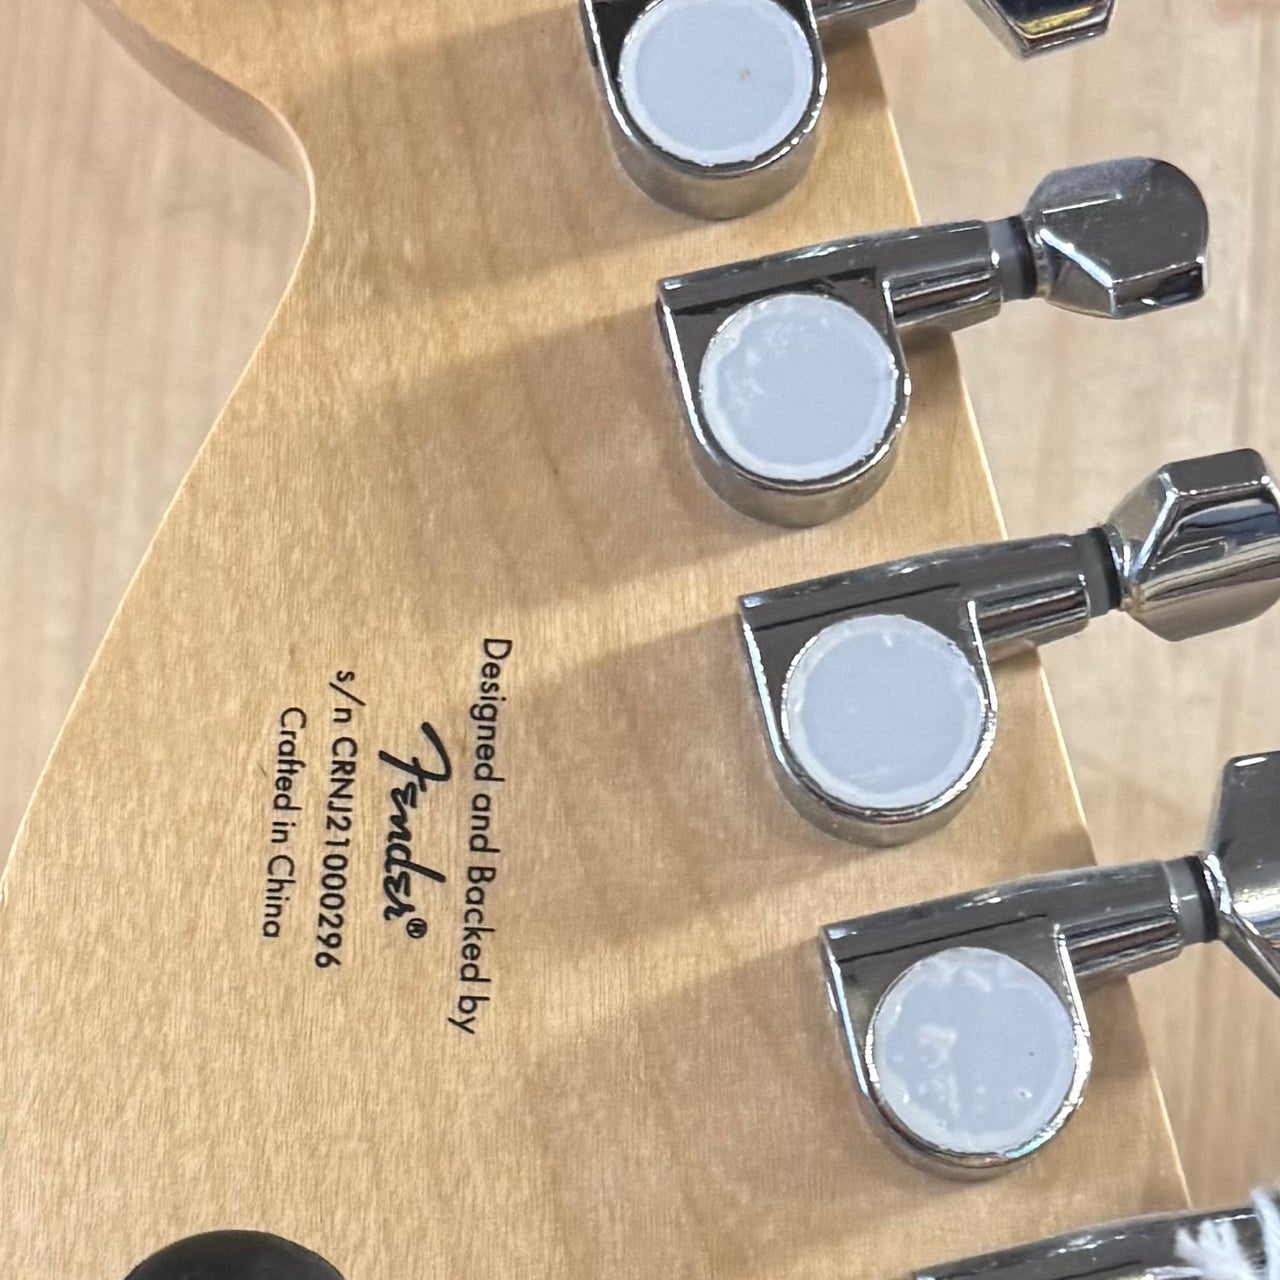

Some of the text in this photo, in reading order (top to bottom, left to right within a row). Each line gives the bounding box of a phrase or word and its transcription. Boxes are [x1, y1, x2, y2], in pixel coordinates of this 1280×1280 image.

[262, 707, 307, 938] Crafted in China
[314, 670, 366, 969] s/n CRNJ21000296
[447, 638, 513, 1035] Designed and Backed by
